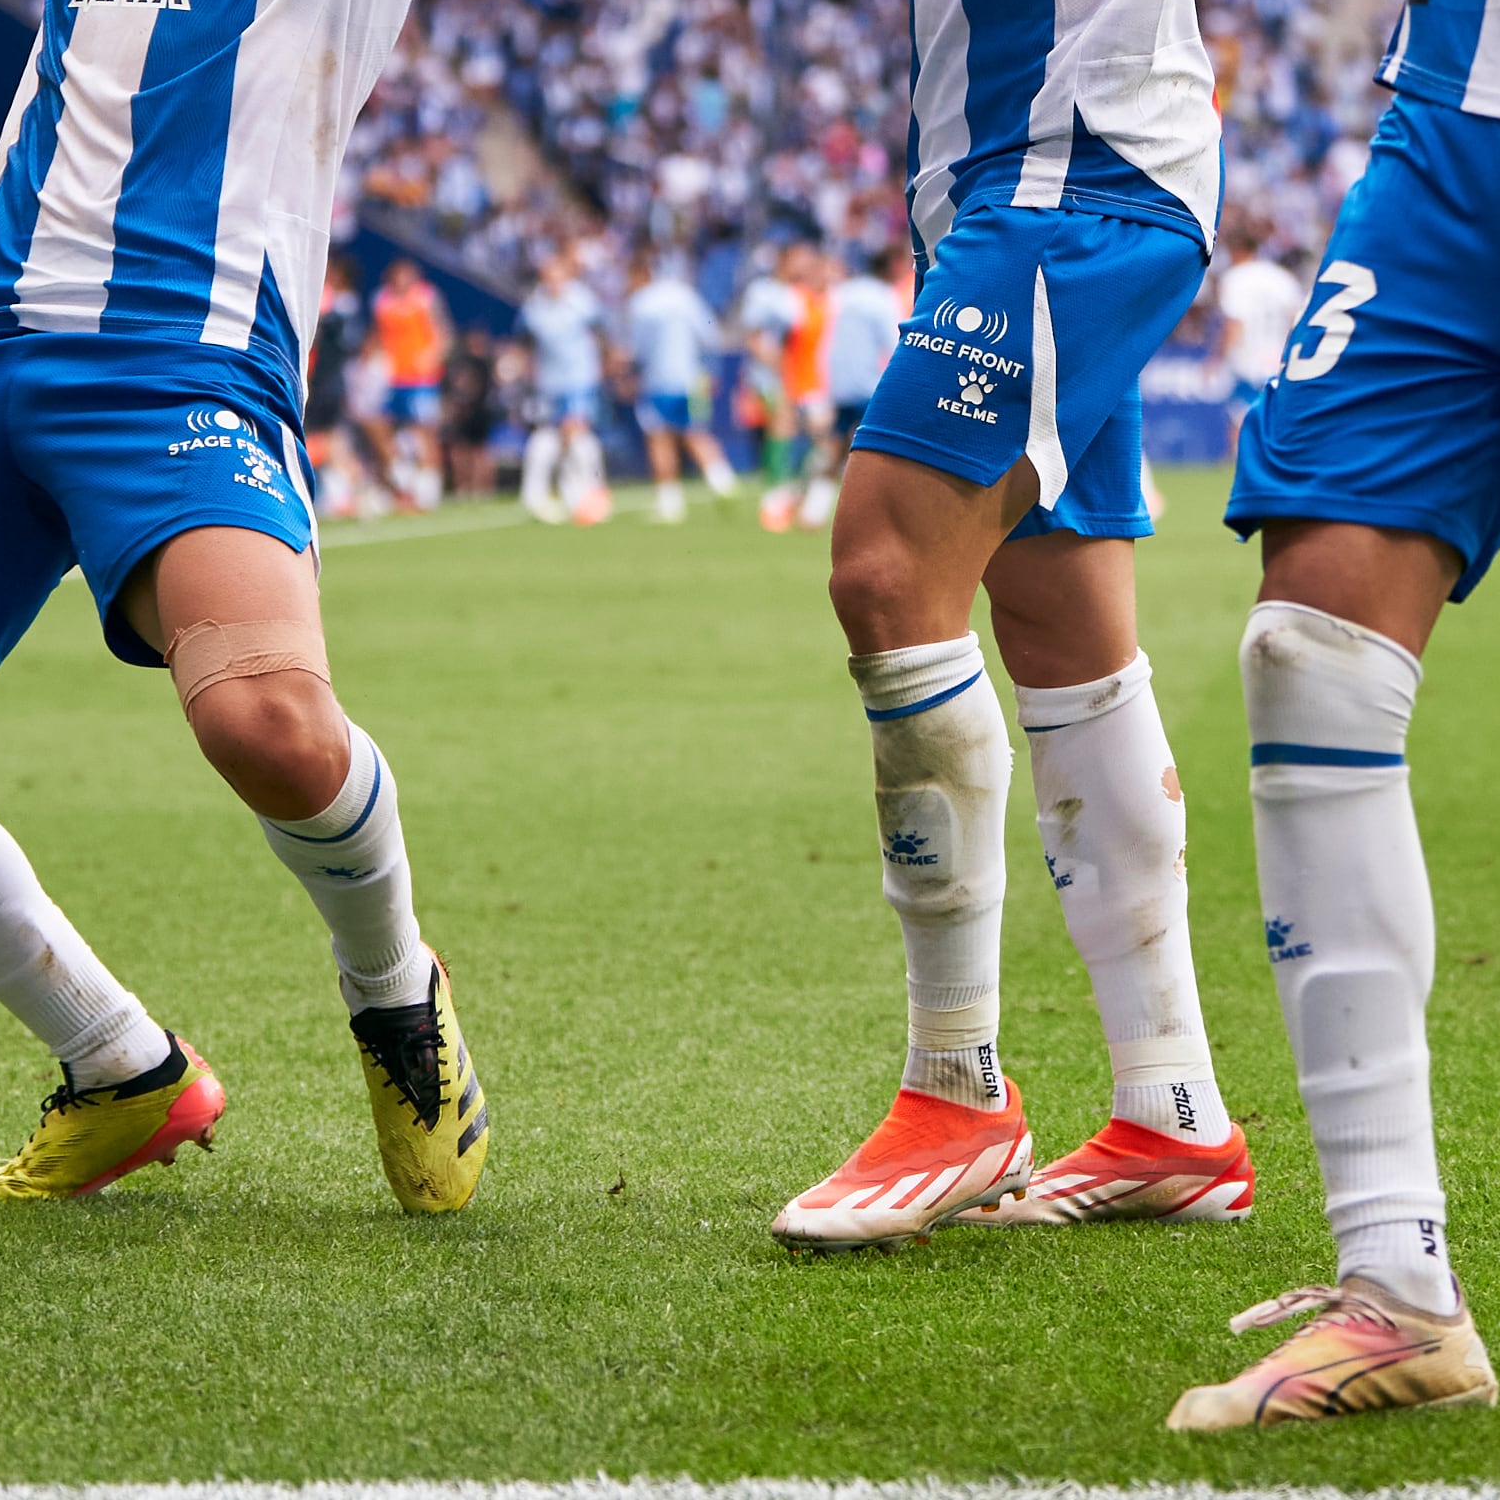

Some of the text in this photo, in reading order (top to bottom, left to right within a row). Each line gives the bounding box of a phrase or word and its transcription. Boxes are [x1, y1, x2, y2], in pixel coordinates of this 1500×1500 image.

[1282, 259, 1379, 383] 3
[903, 331, 1025, 379] STAGE FRONT
[936, 397, 998, 425] KELME
[167, 435, 283, 475] STAGE FRONT
[233, 472, 286, 504] KELME
[978, 1043, 1000, 1098] ESIGN
[1171, 1082, 1197, 1132] SIGN
